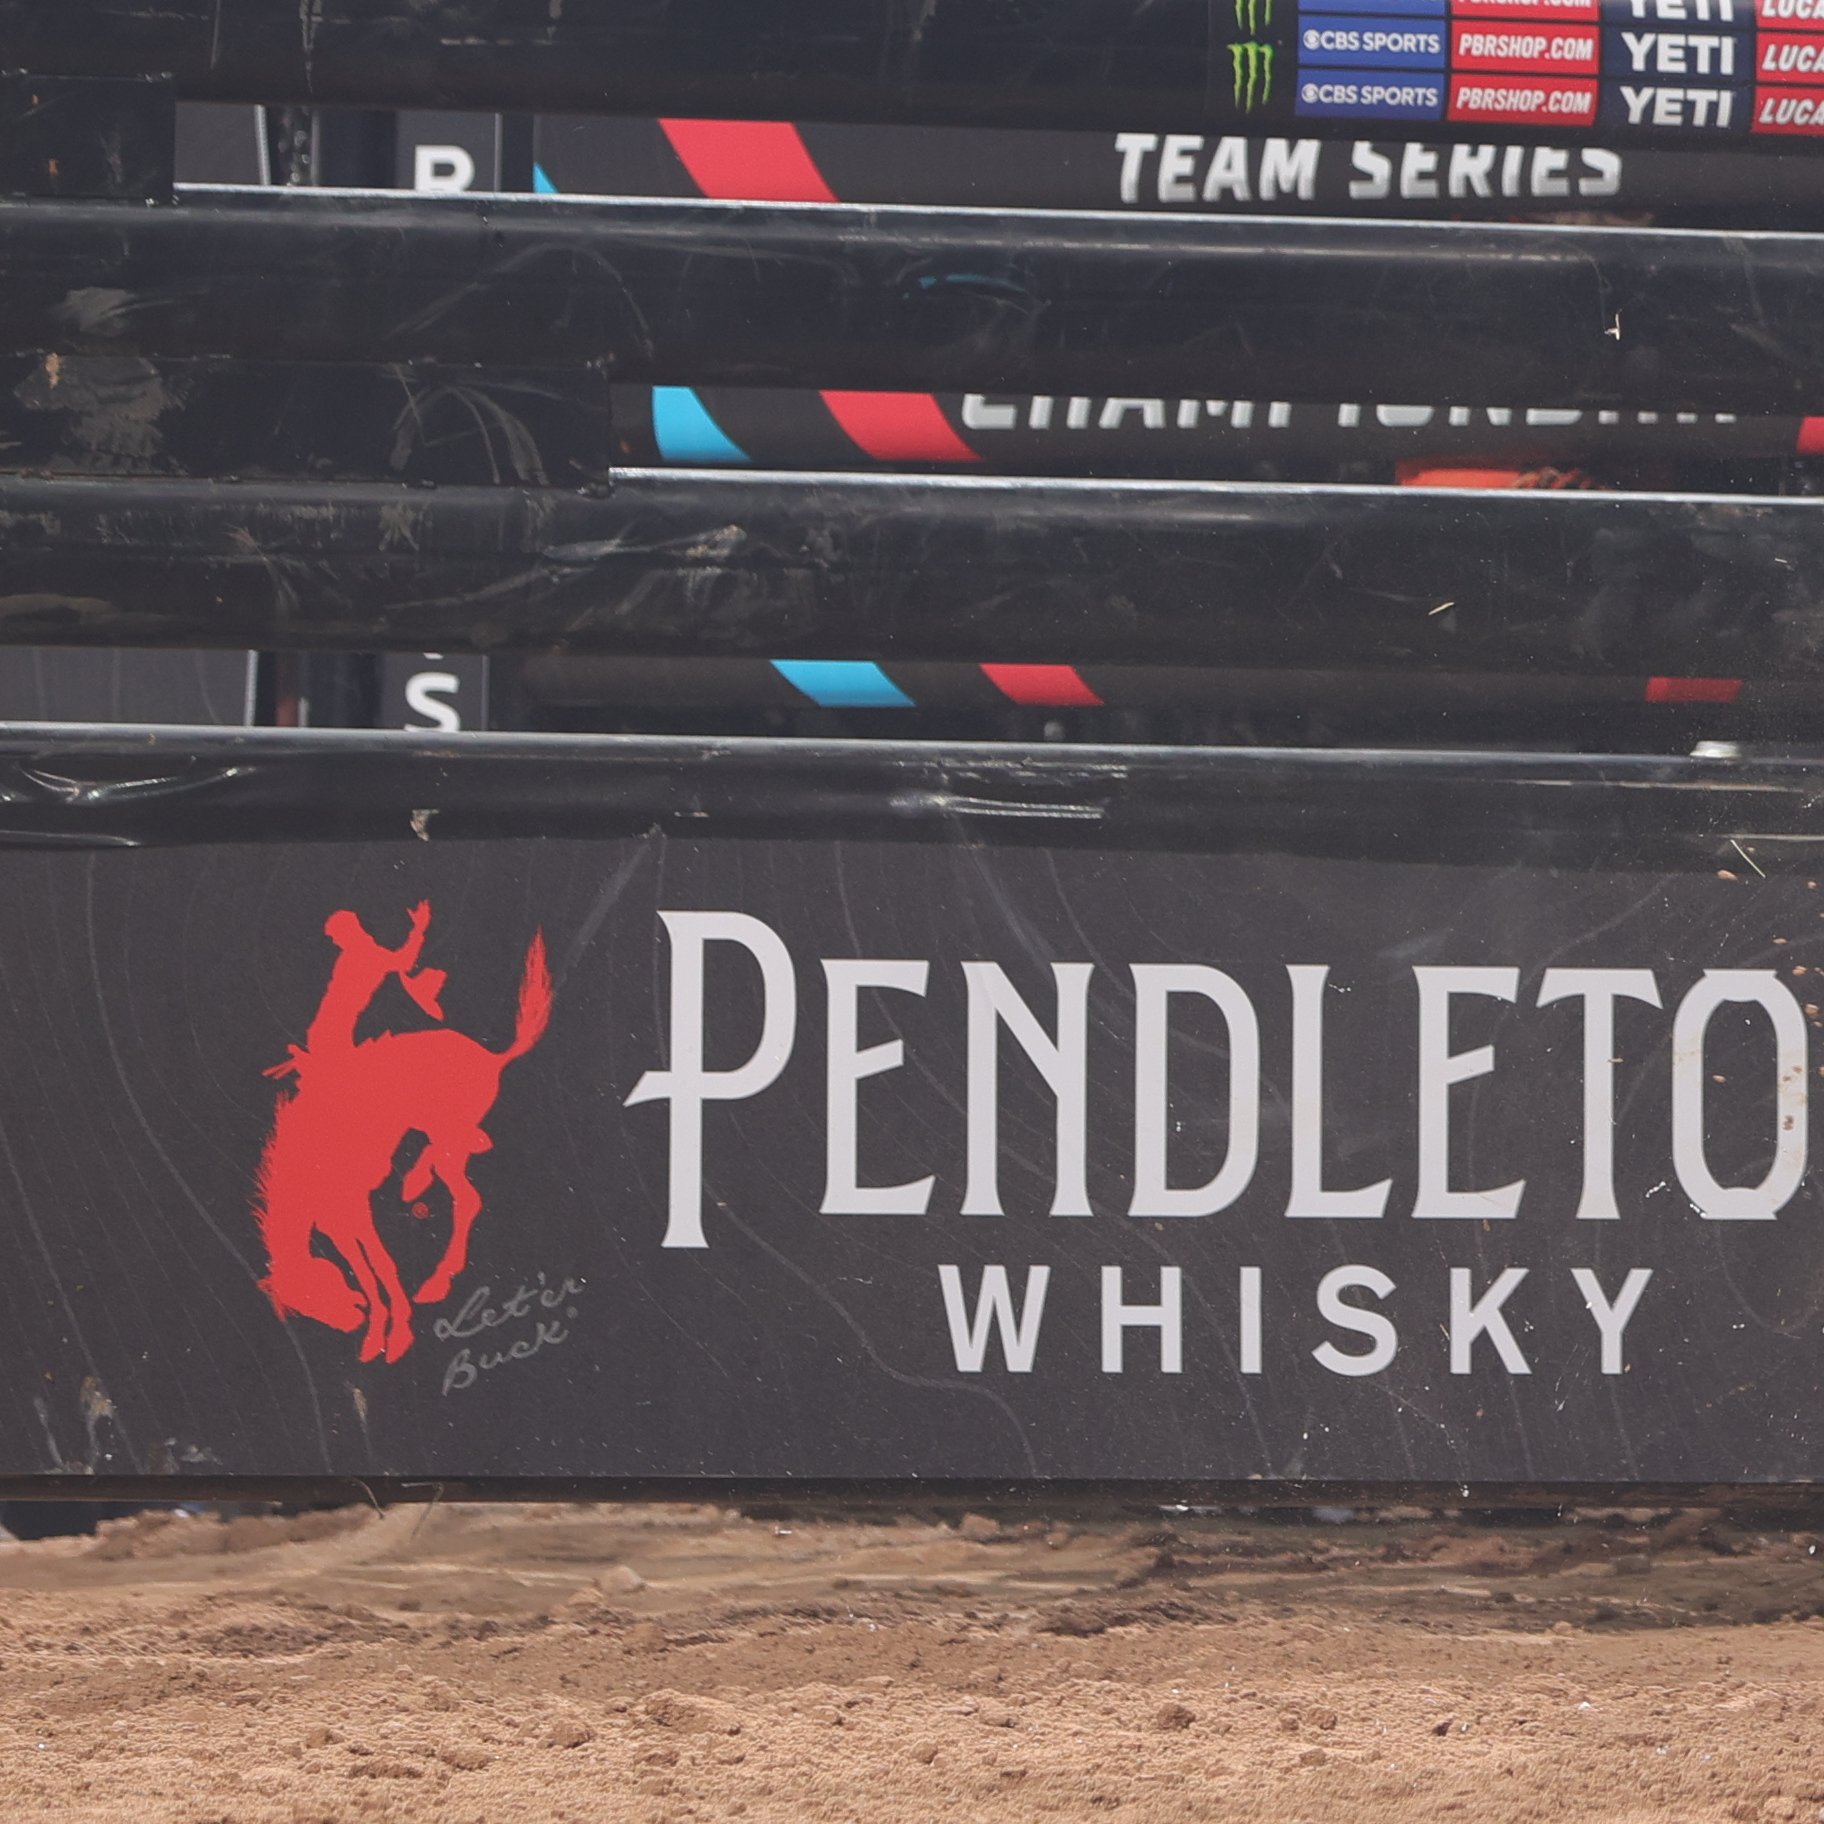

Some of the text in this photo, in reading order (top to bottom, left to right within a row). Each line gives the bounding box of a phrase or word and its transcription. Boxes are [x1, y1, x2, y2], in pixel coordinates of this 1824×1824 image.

[1319, 31, 1440, 54] CBS SPORTS
[1459, 34, 1593, 61] PBRSHOP.COM
[1621, 32, 1734, 75] YETI
[1318, 85, 1438, 106] CBS SPORTS
[1456, 87, 1591, 114] PBRSHOP.COM
[1620, 86, 1732, 127] YETI
[1114, 133, 1320, 203] TEAM
[937, 1263, 1654, 1376] WHISKY
[442, 1321, 570, 1397] Buck
